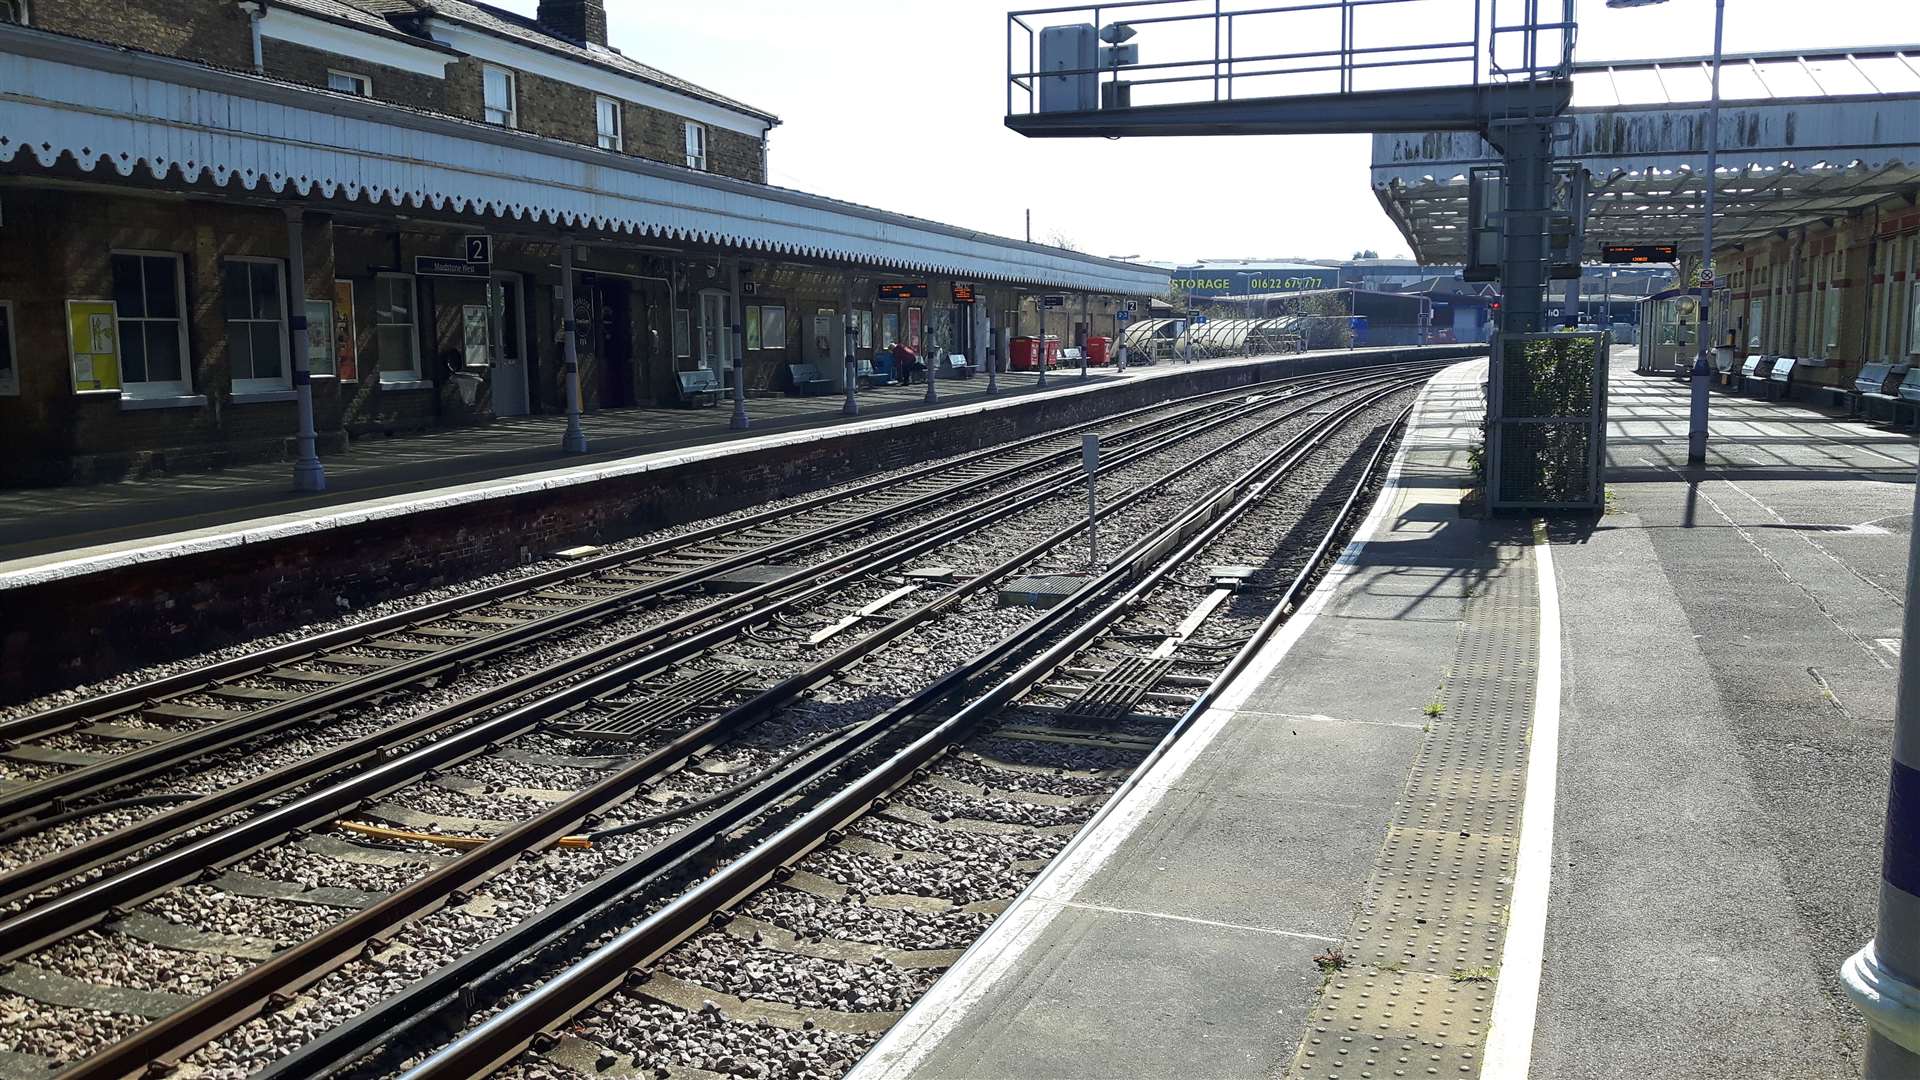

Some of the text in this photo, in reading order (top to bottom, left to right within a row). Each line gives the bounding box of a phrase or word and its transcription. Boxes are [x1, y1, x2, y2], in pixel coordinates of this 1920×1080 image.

[472, 240, 483, 259] 2
[1171, 278, 1323, 289] STORAGE 01622 679 777
